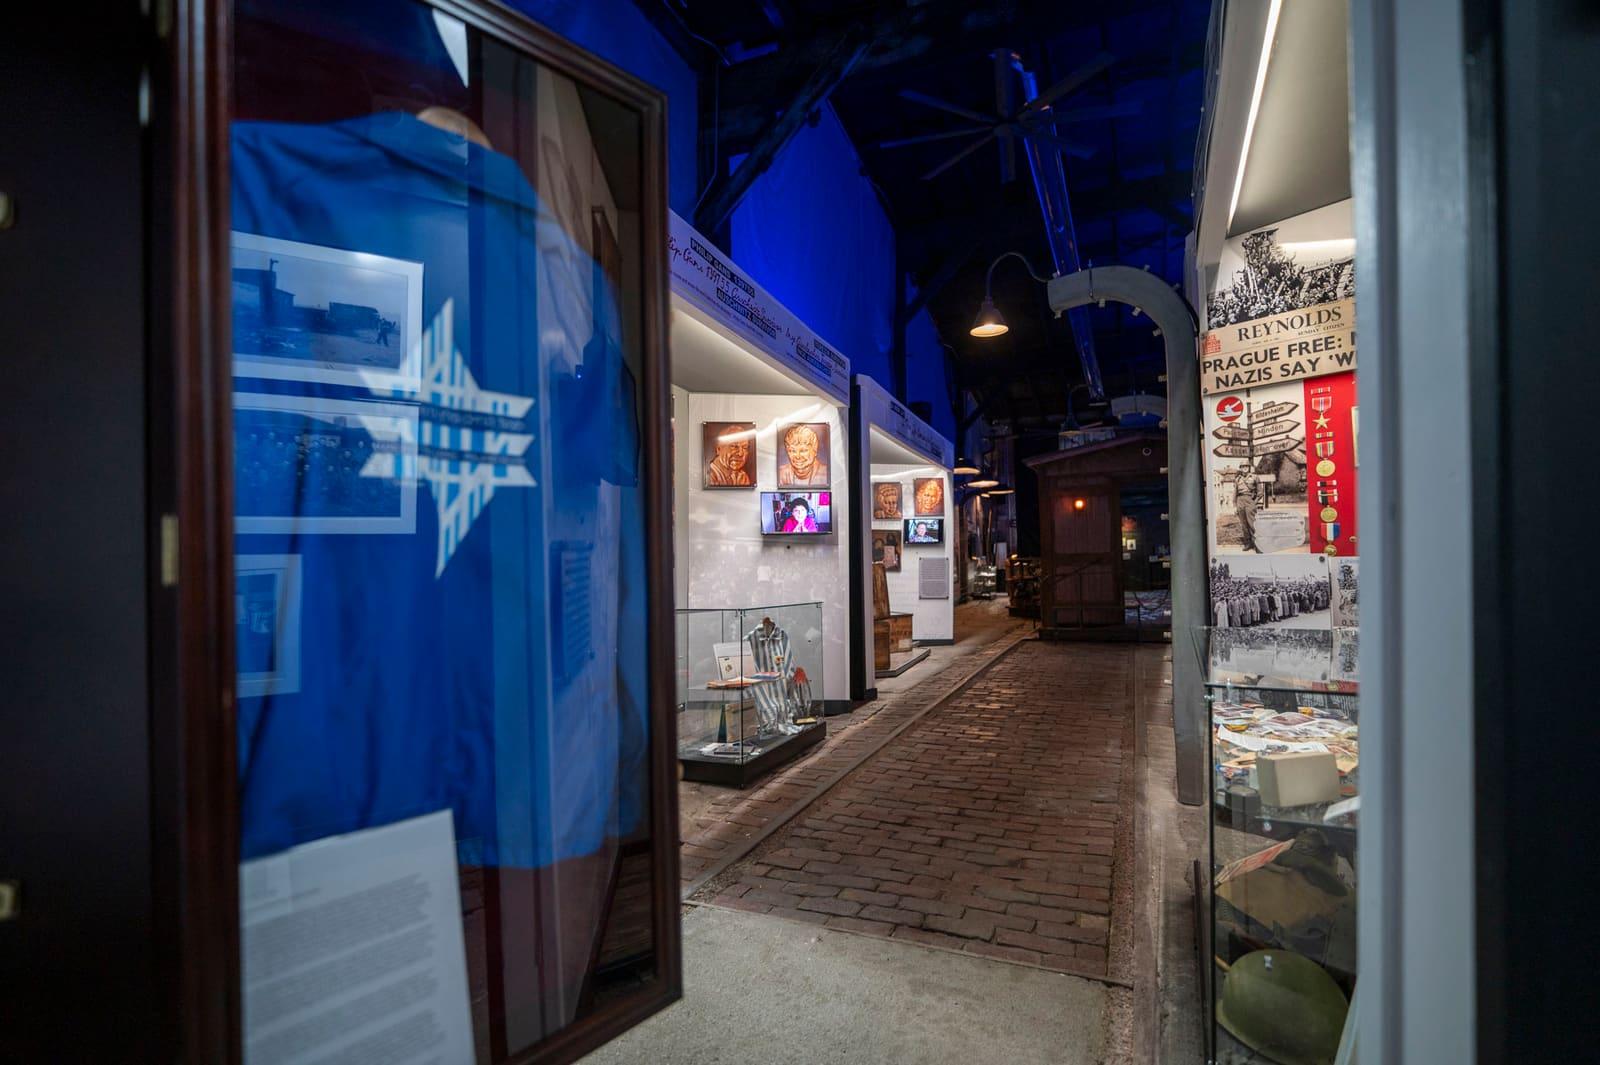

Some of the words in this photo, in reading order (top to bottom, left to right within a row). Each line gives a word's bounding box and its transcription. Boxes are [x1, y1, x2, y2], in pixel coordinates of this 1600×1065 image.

[692, 240, 713, 264] PHILIP
[714, 259, 732, 280] GANS
[1238, 306, 1342, 342] REYNOLDS
[1202, 347, 1280, 374] PRAGUE
[1287, 335, 1342, 358] FREE:
[1215, 366, 1272, 390] NAZIS
[1280, 356, 1321, 378] SAY
[1257, 424, 1284, 435] Minden
